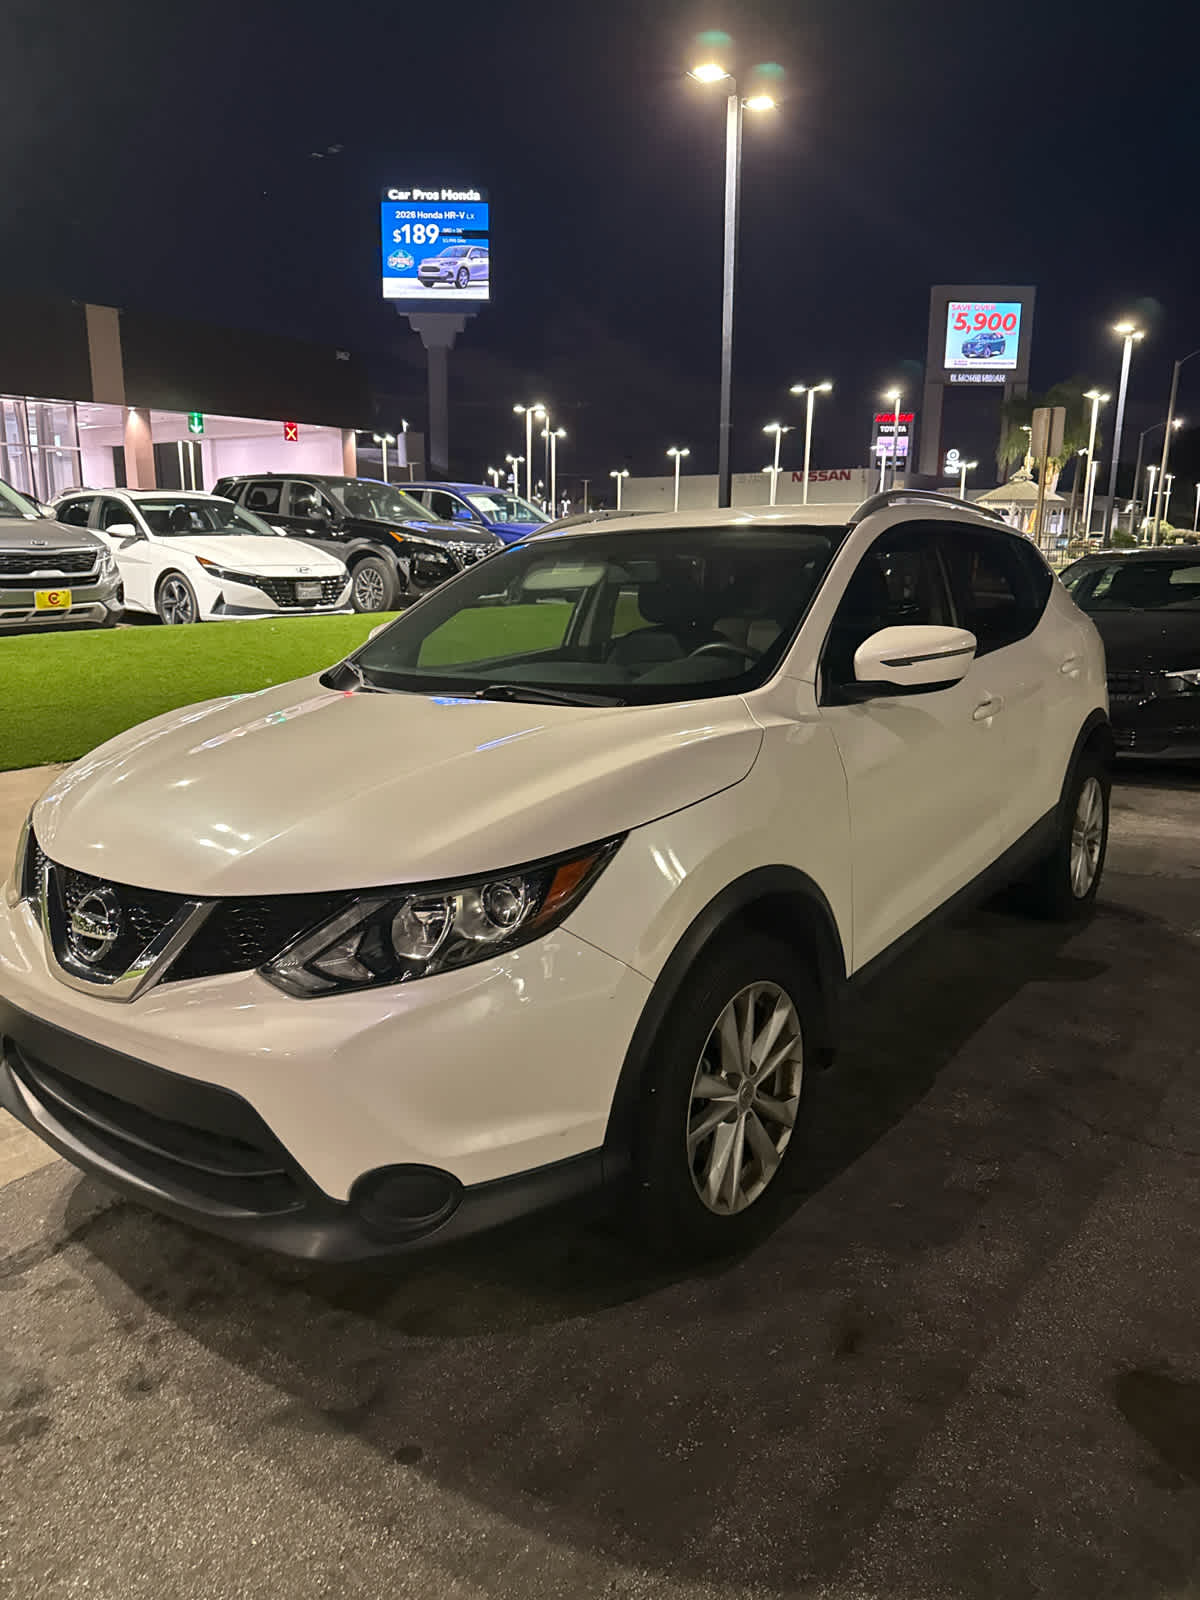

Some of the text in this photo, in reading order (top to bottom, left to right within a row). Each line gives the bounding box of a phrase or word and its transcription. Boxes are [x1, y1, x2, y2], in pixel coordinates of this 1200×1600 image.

[388, 189, 481, 201] Car Pros Honda
[417, 211, 443, 219] Honda
[444, 211, 465, 219] HR-V
[393, 224, 440, 244] $189
[792, 470, 851, 482] NSSAN
